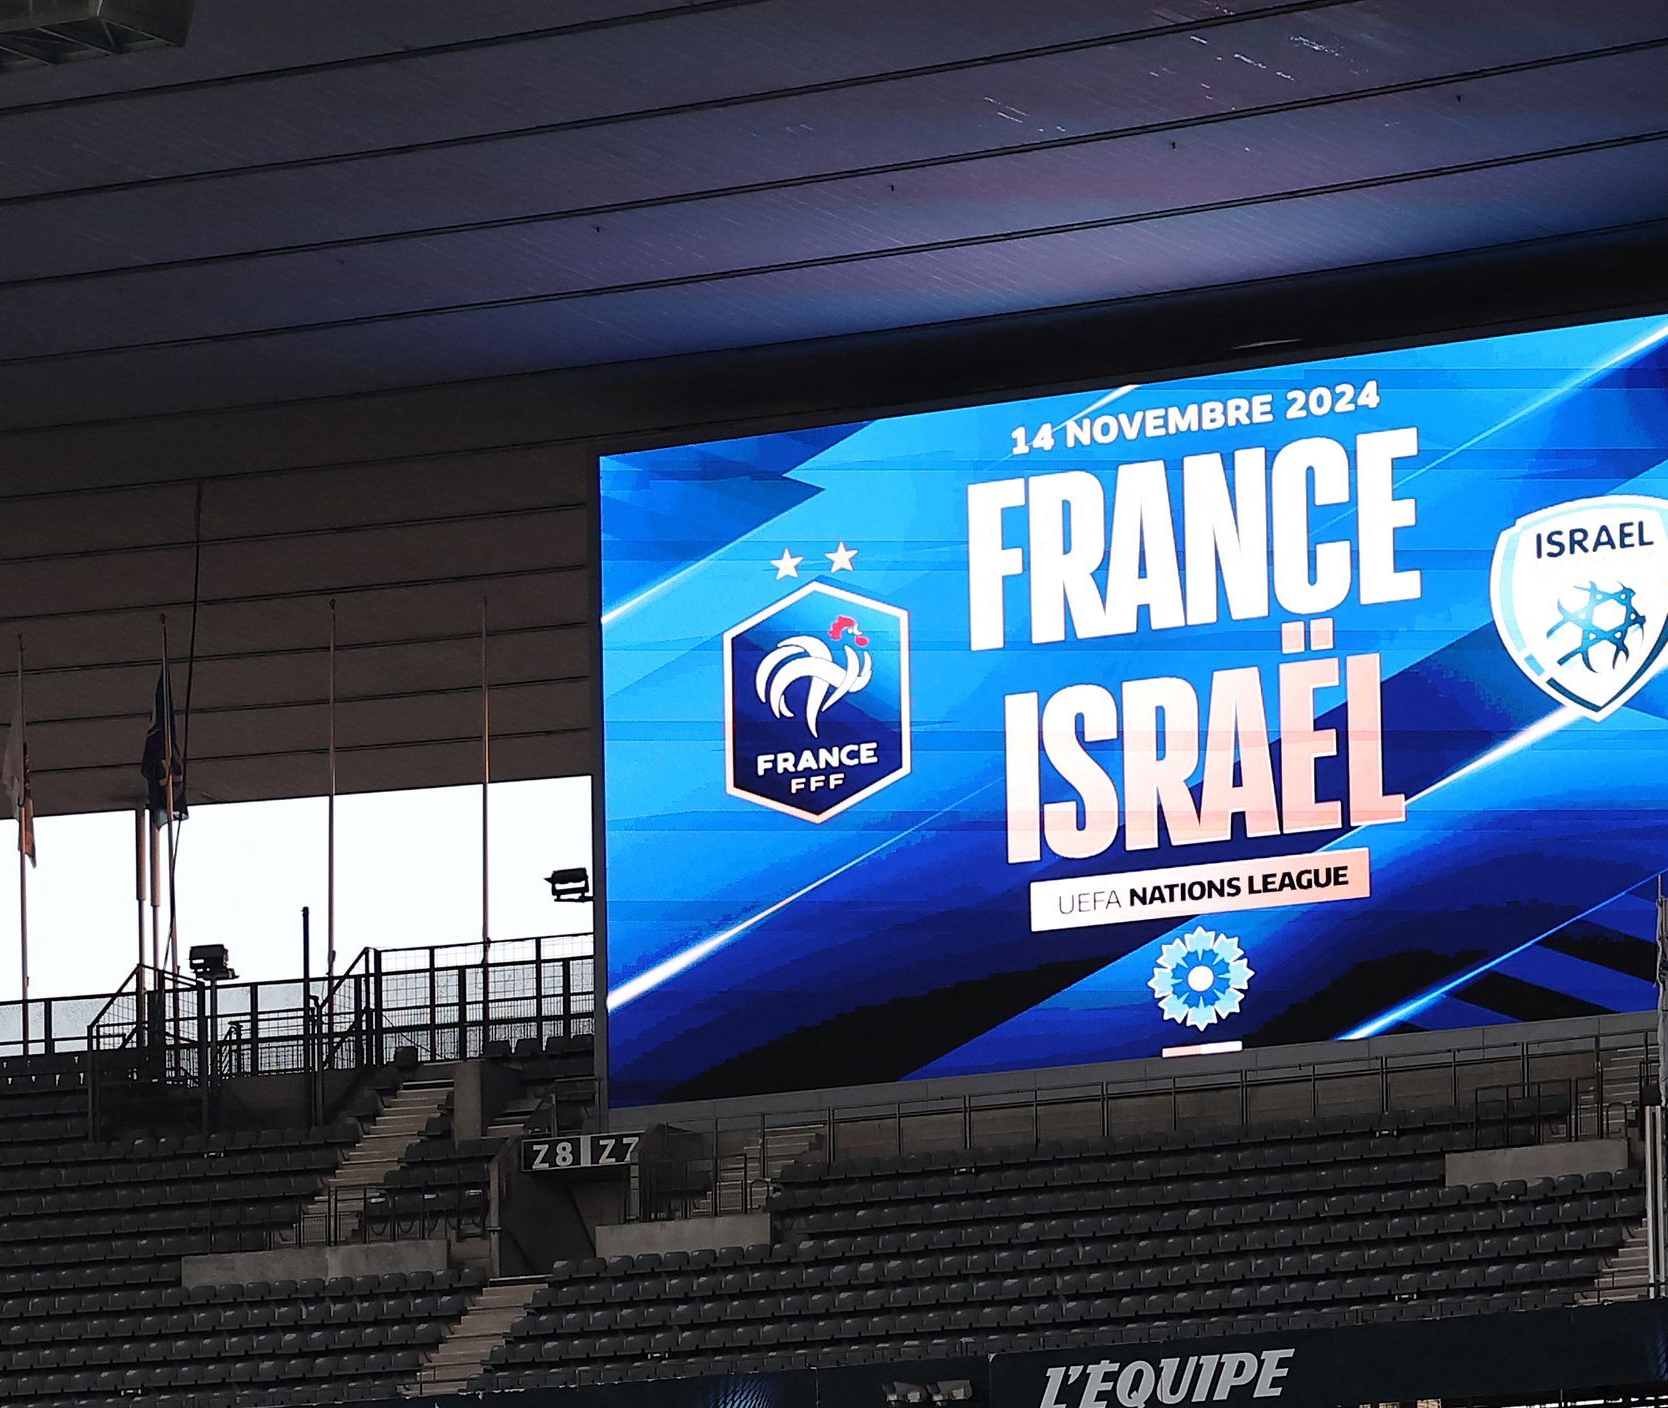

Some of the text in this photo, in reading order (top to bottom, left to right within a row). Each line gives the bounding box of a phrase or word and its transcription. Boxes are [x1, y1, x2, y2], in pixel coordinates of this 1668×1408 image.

[1011, 380, 1381, 455] 14 NOVEMBRE 2024
[967, 426, 1422, 651] FRANCE
[1536, 521, 1654, 559] ISRAEL
[757, 742, 879, 776] FRANCE
[1004, 617, 1407, 864] ISRAËL
[790, 773, 845, 794] FFF
[1058, 865, 1349, 915] UEFA NATIONS LEAGUE
